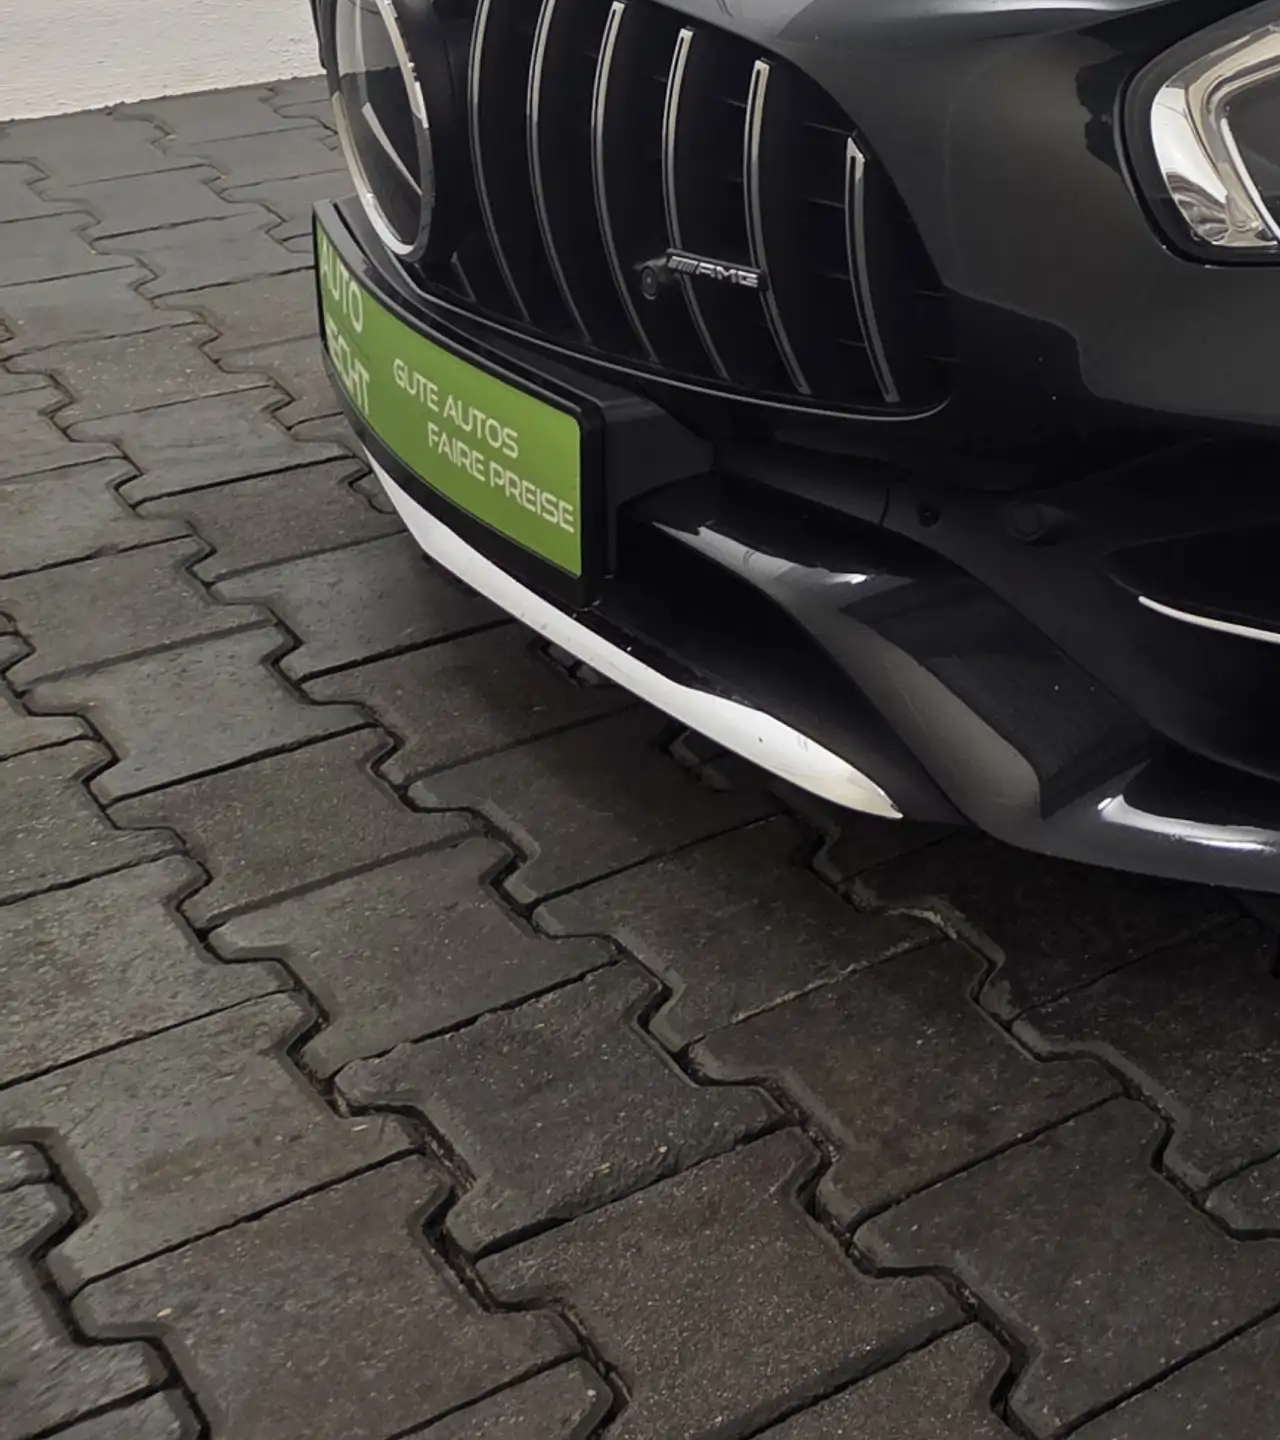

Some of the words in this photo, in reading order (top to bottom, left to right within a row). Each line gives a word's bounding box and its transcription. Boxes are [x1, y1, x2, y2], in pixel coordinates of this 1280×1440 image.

[320, 235, 365, 334] AUTO
[324, 313, 371, 415] ECHT
[393, 358, 440, 412] GUTE
[443, 394, 519, 459] AUTOS
[427, 421, 486, 482] FAIRE
[489, 460, 575, 534] PREISE
